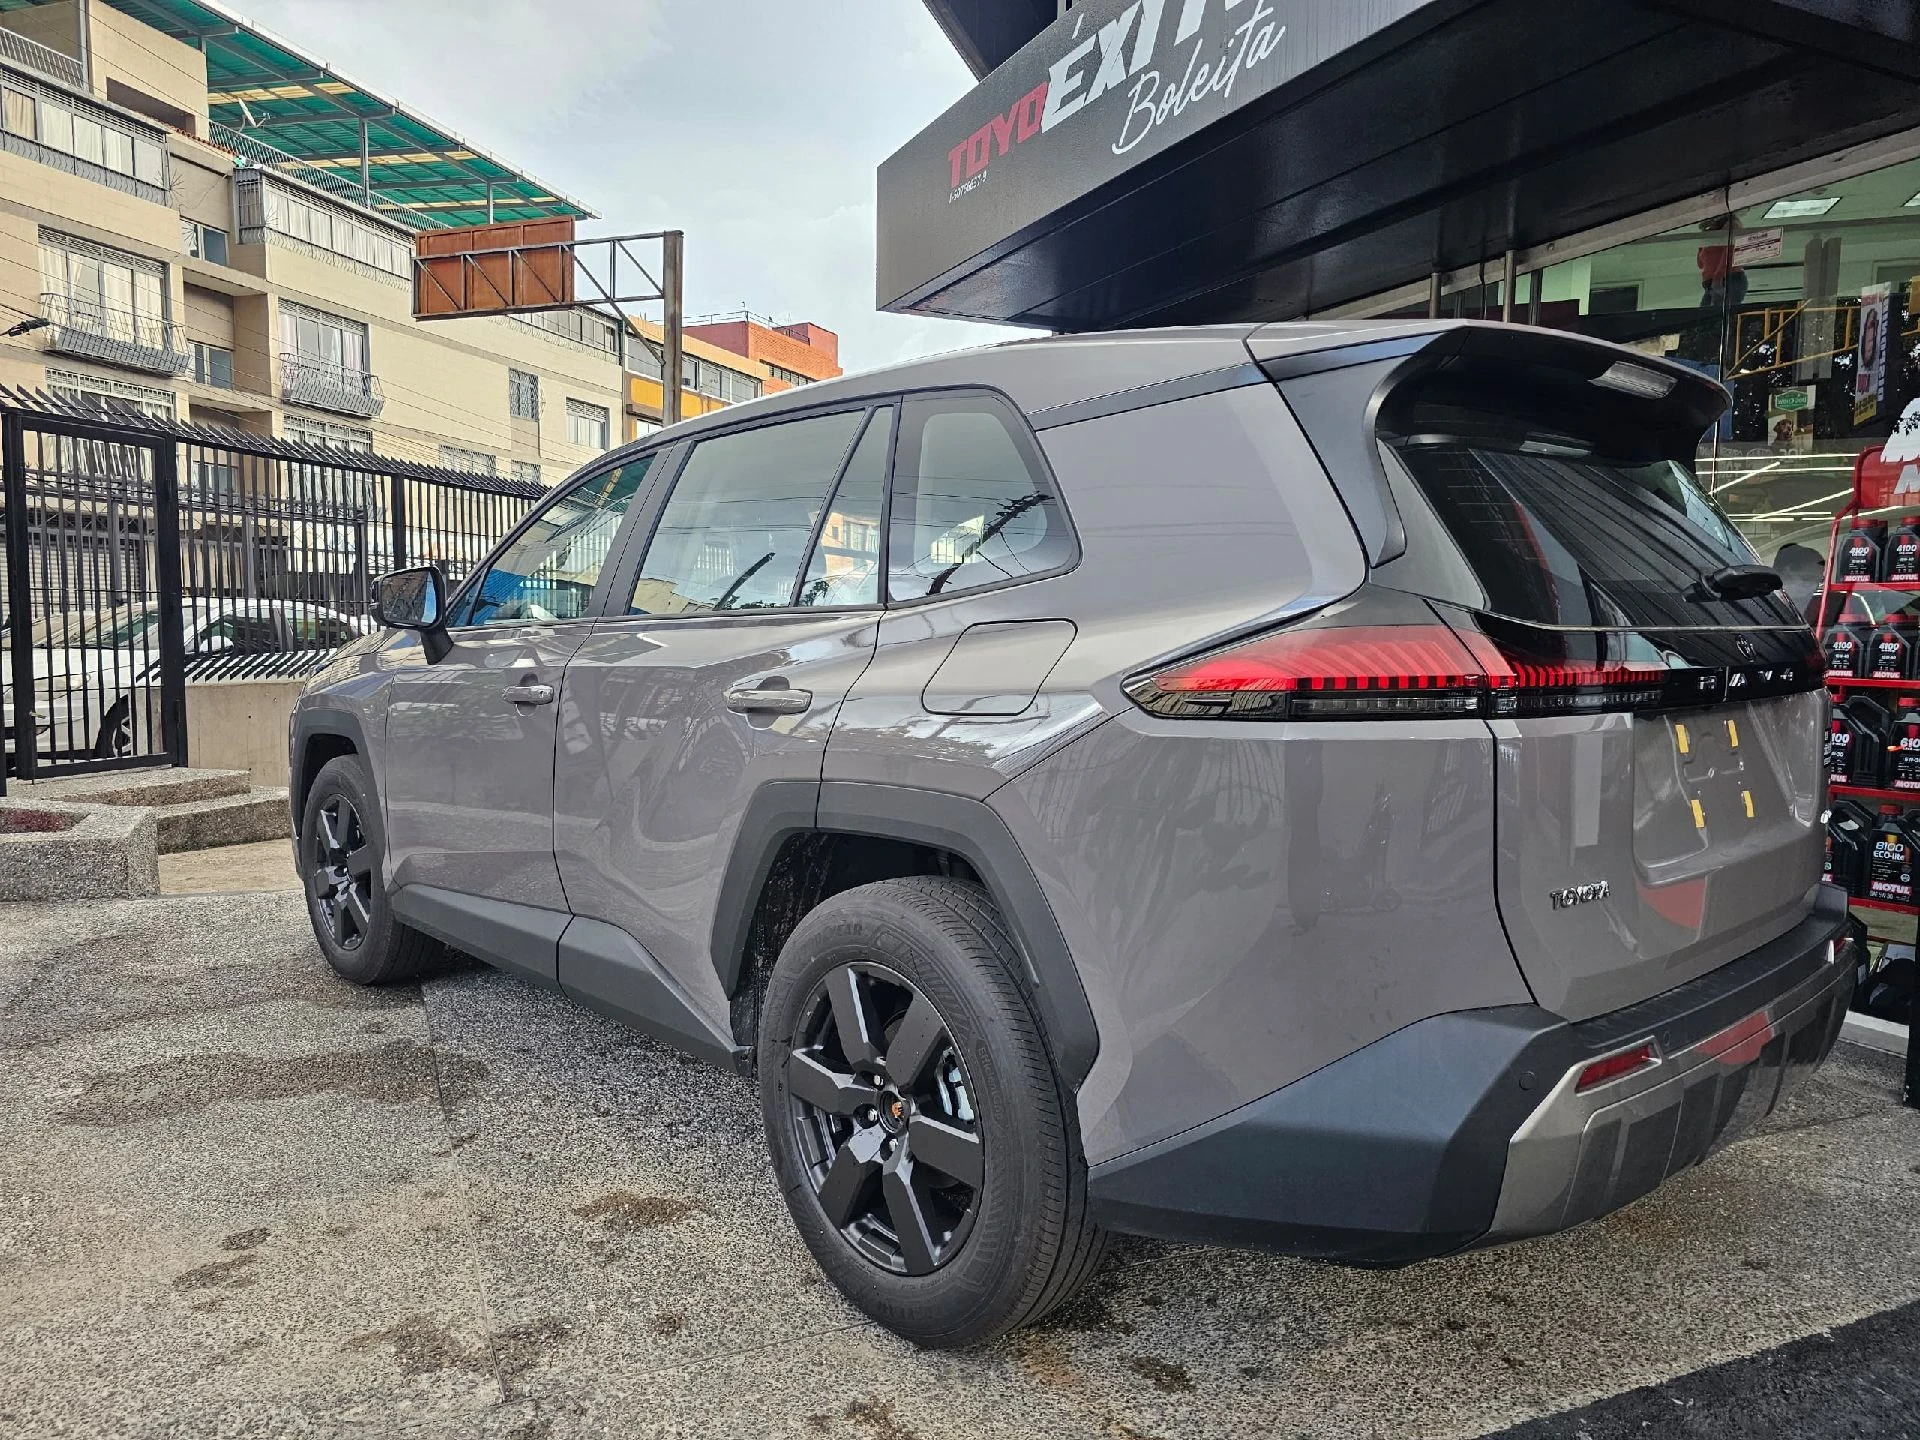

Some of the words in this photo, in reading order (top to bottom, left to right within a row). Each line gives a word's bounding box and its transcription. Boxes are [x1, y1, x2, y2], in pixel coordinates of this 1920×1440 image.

[1896, 544, 1917, 552] 4100
[1832, 641, 1853, 650] 4100
[1878, 642, 1900, 651] 4100
[1827, 669, 1854, 678] MOTUL
[1873, 671, 1901, 679] MOTUL
[1830, 732, 1850, 744] 100
[1875, 841, 1904, 852] 8100
[1871, 881, 1911, 895] MOTUL
[1550, 880, 1611, 910] TOYOTA
